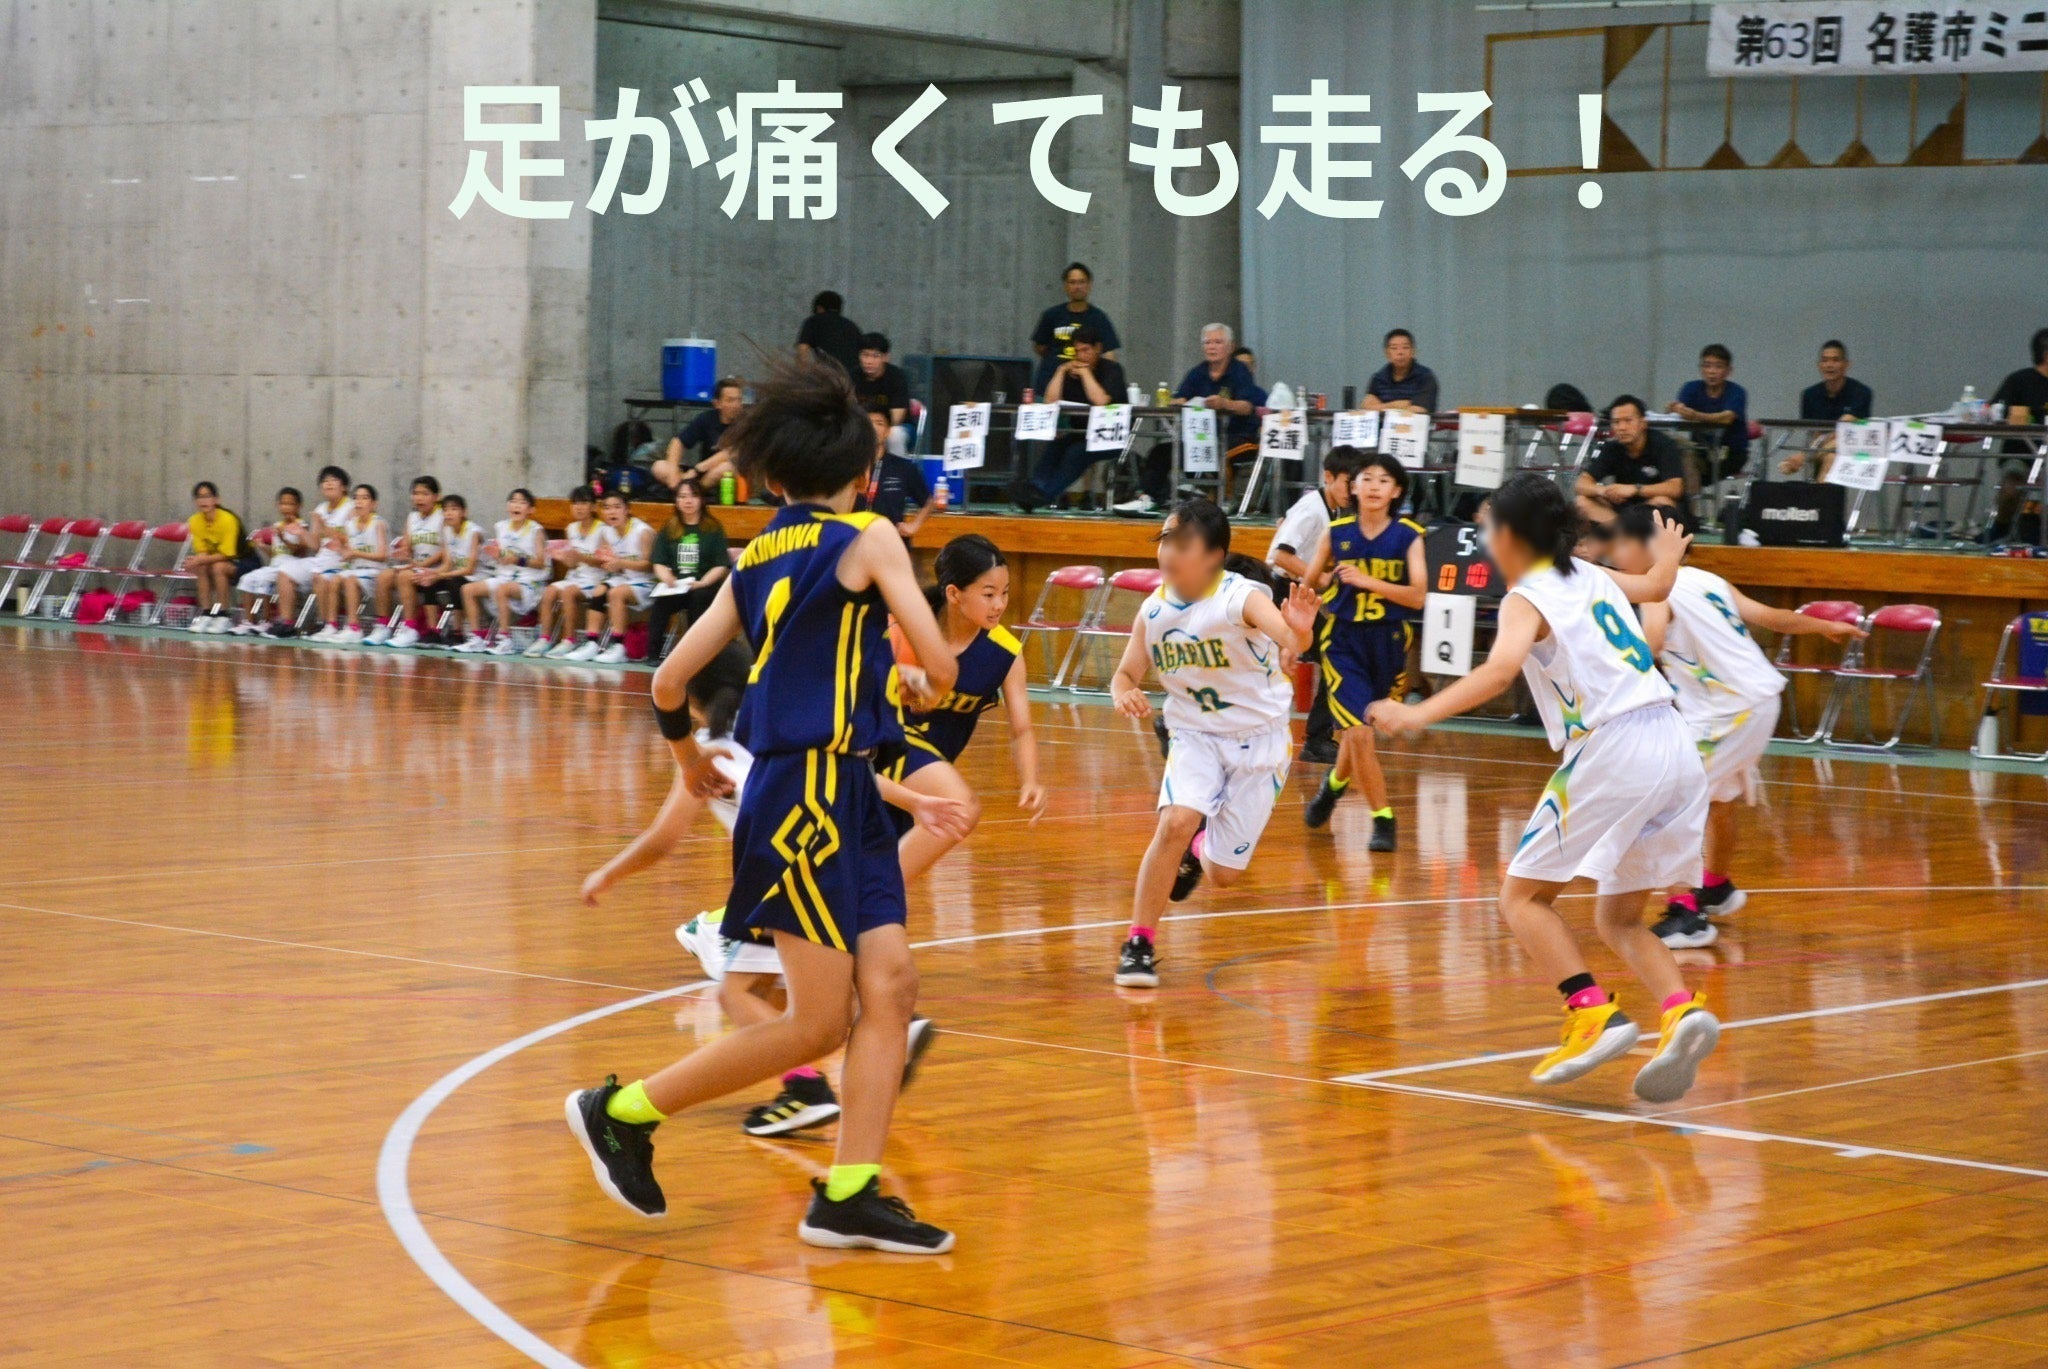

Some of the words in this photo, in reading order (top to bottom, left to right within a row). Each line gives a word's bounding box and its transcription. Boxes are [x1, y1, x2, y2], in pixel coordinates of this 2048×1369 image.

[1735, 14, 1843, 67] 第63回
[1866, 10, 2048, 65] 名護市ミニ
[1353, 592, 1386, 622] 15
[1591, 599, 1655, 675] 9
